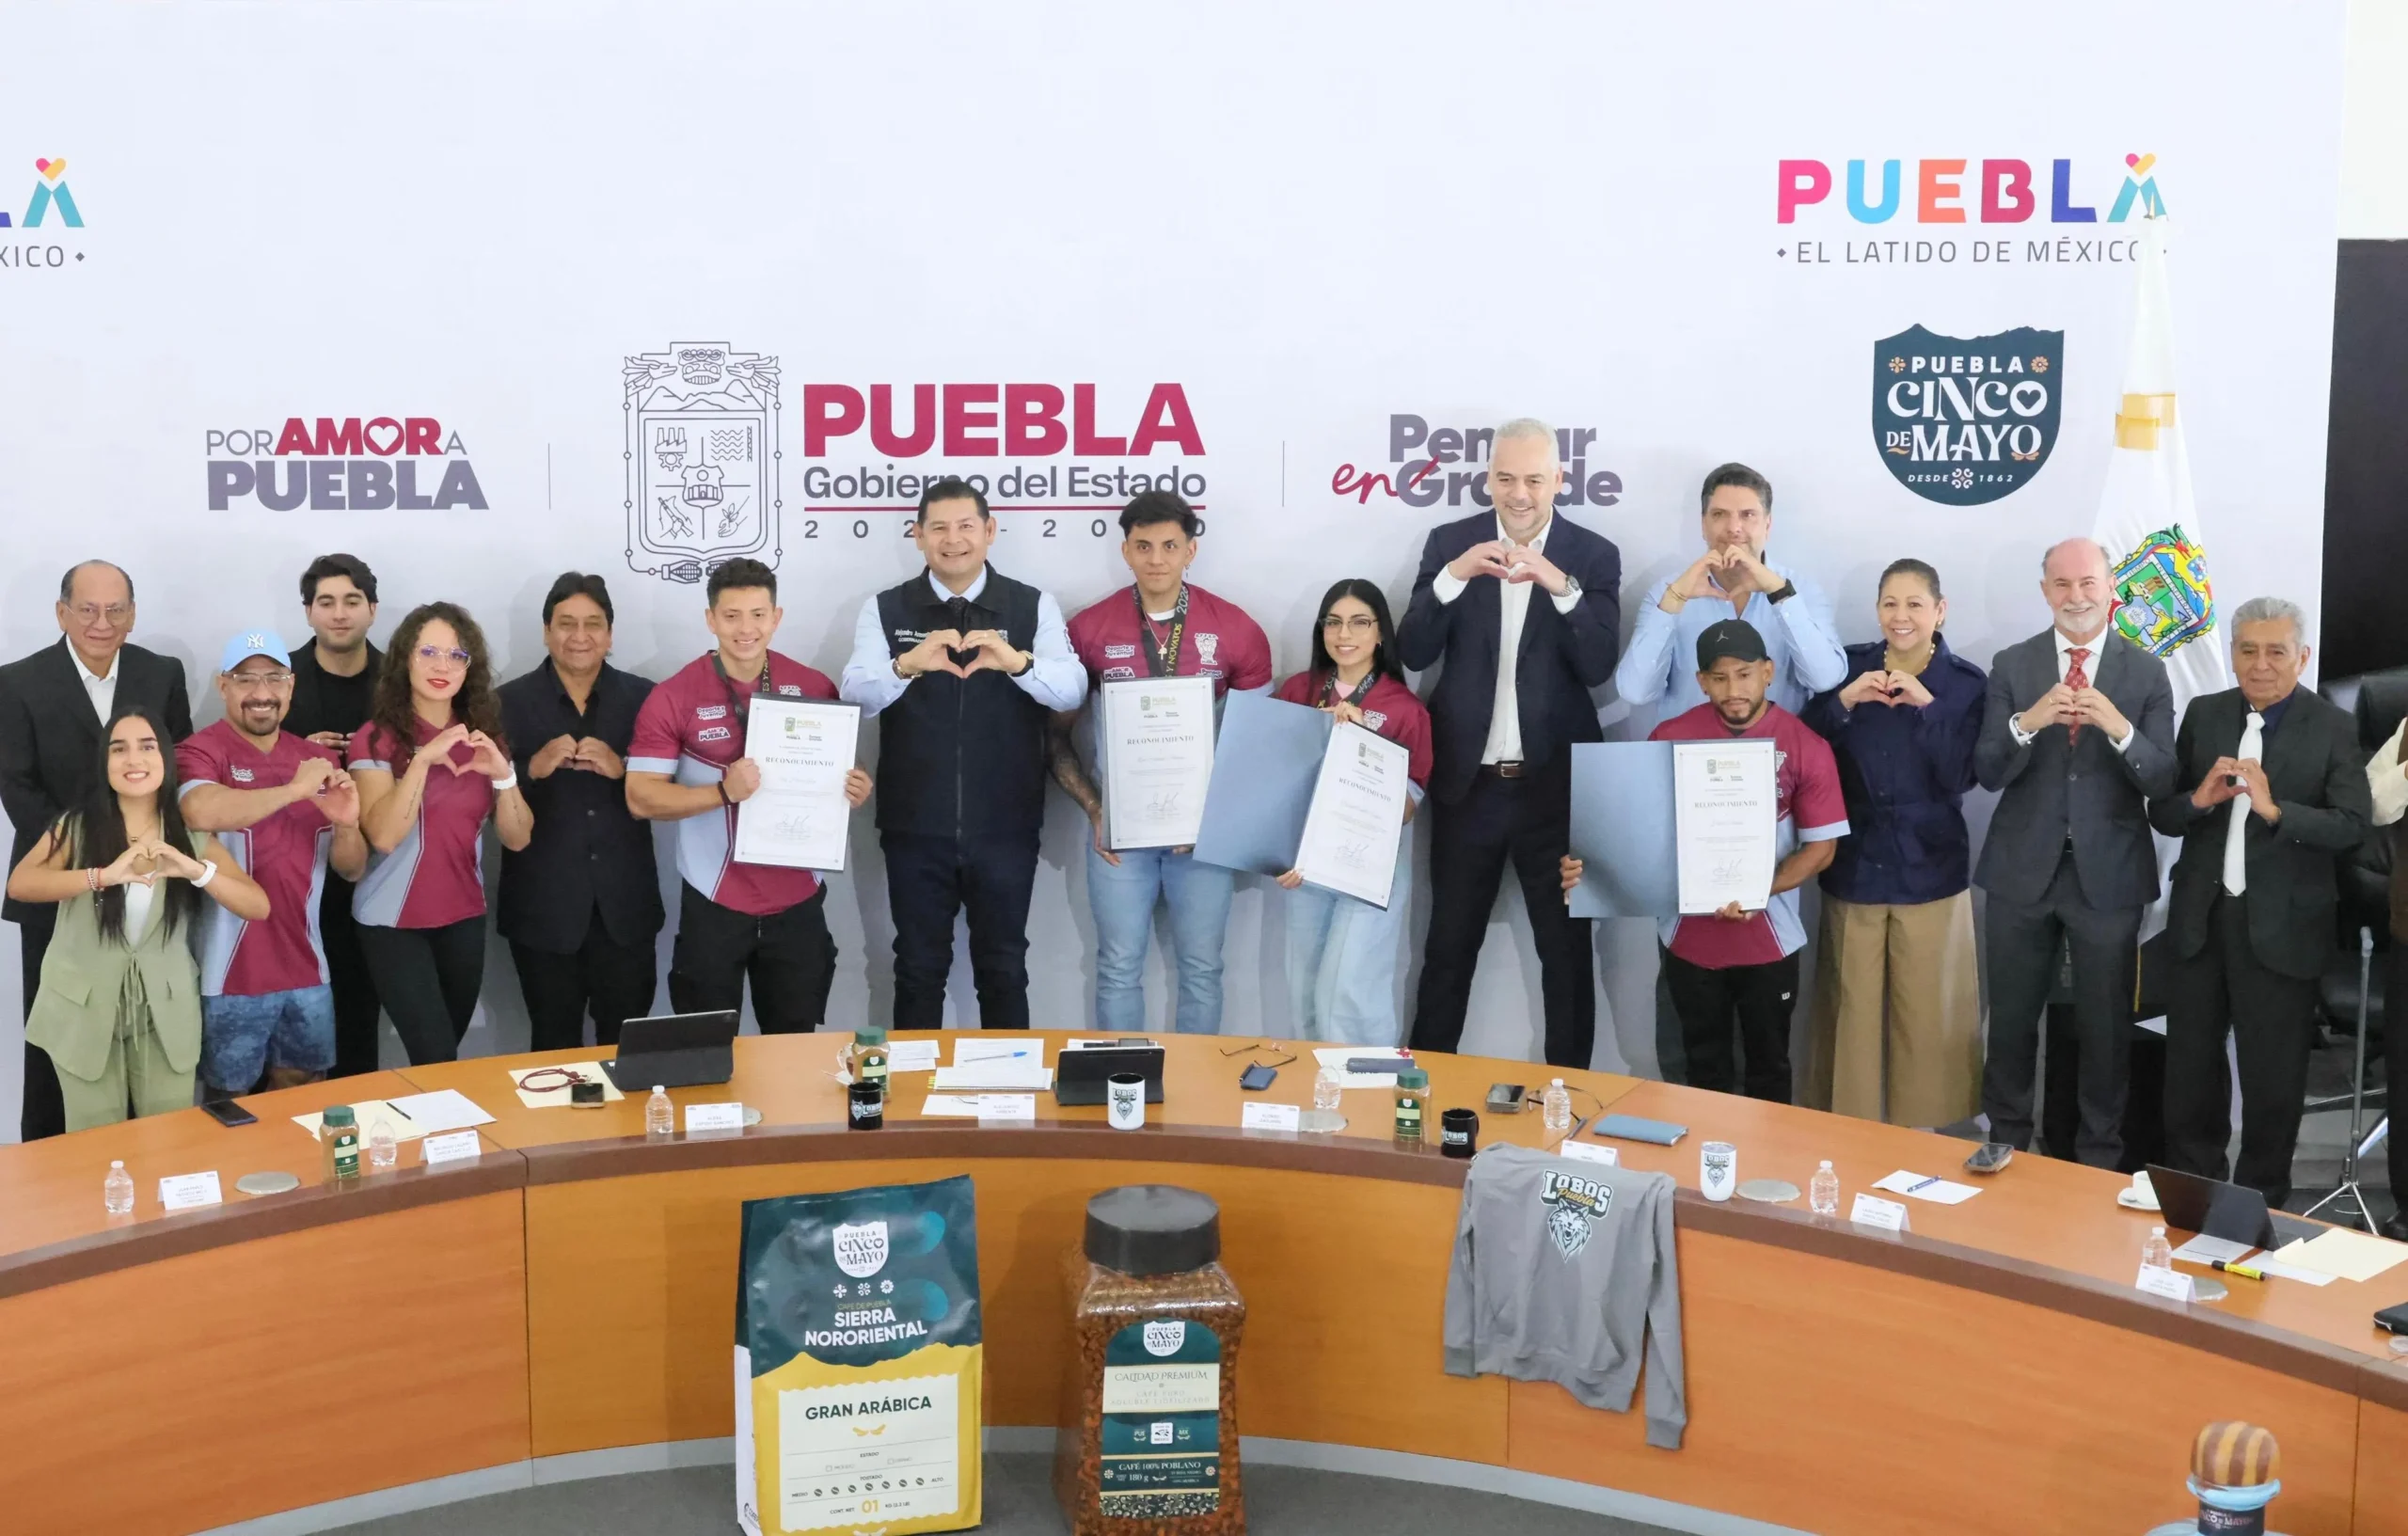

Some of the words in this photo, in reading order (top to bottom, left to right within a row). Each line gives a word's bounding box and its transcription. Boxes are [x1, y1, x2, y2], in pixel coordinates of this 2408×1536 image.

[1777, 153, 2169, 224] PUEBLA
[1798, 242, 1830, 262] EL
[1846, 242, 1956, 262] LATIDO
[1973, 242, 2011, 262] DE
[1911, 356, 2024, 373] PUEBLA
[1887, 377, 2048, 420] CINCO
[803, 383, 1206, 458] PUEBLA
[206, 430, 273, 456] POR
[274, 417, 444, 456] AMOR
[443, 430, 467, 455] A
[1390, 414, 1596, 463] Penr
[1886, 431, 1911, 447] DE
[1910, 424, 2042, 461] MAYO
[207, 460, 489, 512] PUEBLA
[804, 464, 989, 499] Gobiero
[997, 466, 1057, 499] del
[1069, 466, 1206, 498] Estado
[1396, 459, 1624, 508] Grde
[1908, 474, 1949, 483] DESDE
[1979, 474, 2013, 483] 1862
[804, 519, 918, 539] 202
[1042, 519, 1206, 538] 200
[1169, 623, 1182, 665] NOVATOS
[700, 732, 729, 740] PUEBLA
[1127, 735, 1194, 746] RECONOCIMIENTO
[765, 756, 834, 767] RECONOCIMIENTO
[1339, 777, 1391, 801] RECONOCIMIENTO
[1694, 800, 1758, 809] RECONOCIMIENTO
[1445, 1132, 1467, 1142] LOBOS
[1542, 1170, 1612, 1219] LOBOS
[1557, 1187, 1596, 1206] Puebla
[838, 1238, 884, 1252] CINCO
[847, 1251, 884, 1265] MAYO
[834, 1307, 896, 1327] SIERRA
[805, 1321, 927, 1346] NORORIENTAL
[1148, 1331, 1180, 1339] CINCO
[1152, 1339, 1180, 1348] MAYO
[1115, 1372, 1160, 1382] CALIDAD
[1162, 1370, 1208, 1380] PREMIUM
[805, 1403, 853, 1420] GRAN
[858, 1396, 932, 1416] ARÁBICA
[1119, 1462, 1140, 1470] CAFÉ
[862, 1499, 879, 1513] 01
